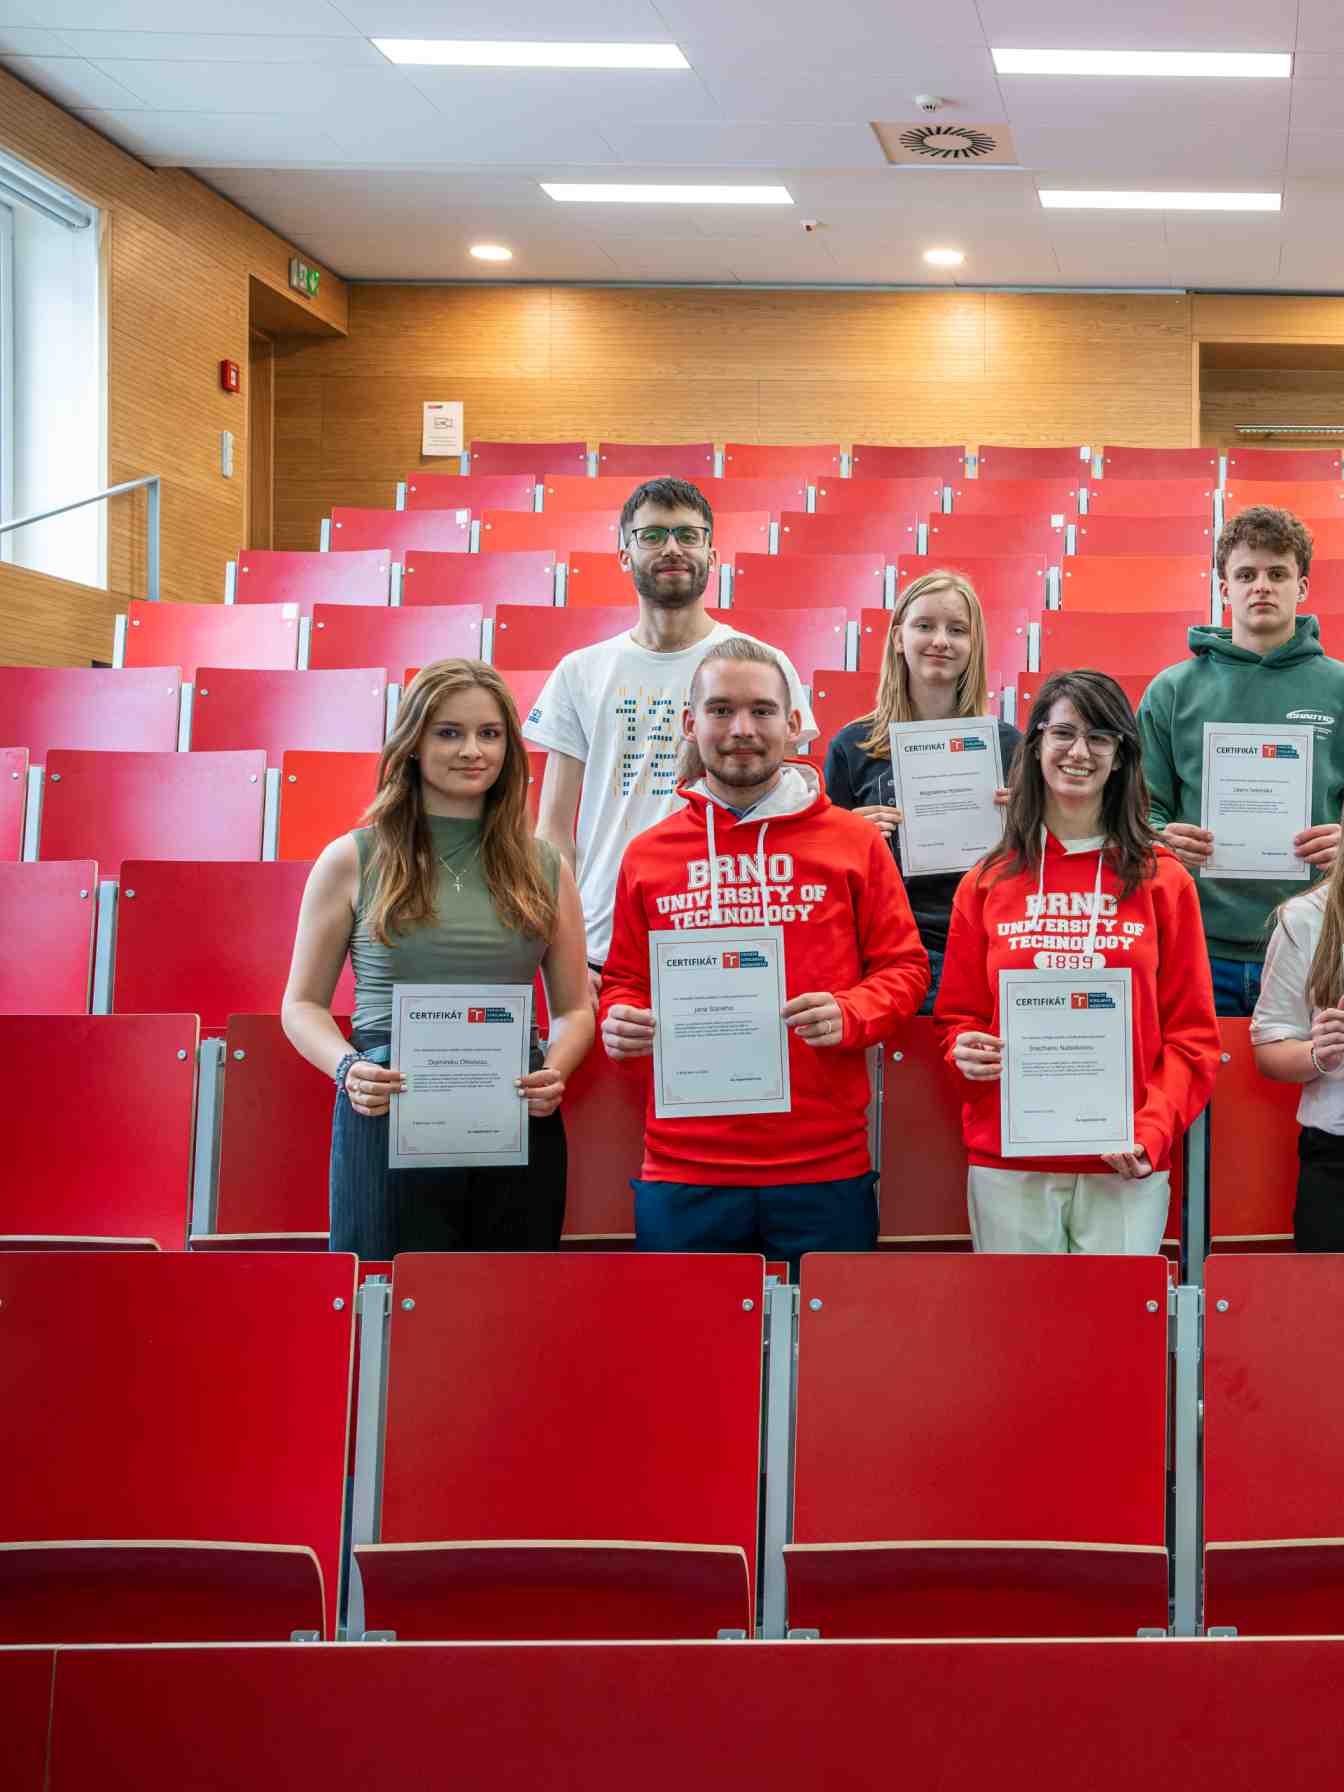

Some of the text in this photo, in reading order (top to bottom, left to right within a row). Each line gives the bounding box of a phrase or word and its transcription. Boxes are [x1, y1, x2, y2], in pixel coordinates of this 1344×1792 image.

[687, 853, 793, 889] BRNO
[656, 884, 827, 914] UNIVRSITY OF
[1025, 892, 1118, 917] BRNO
[670, 904, 814, 930] TECNOLOGY
[1122, 921, 1145, 937] OF
[666, 955, 718, 967] CERTIFIKÁT
[1046, 954, 1094, 970] 1899
[1015, 996, 1066, 1007] CERTIFIKÁT
[409, 1009, 463, 1020] CERTIFIKÁT
